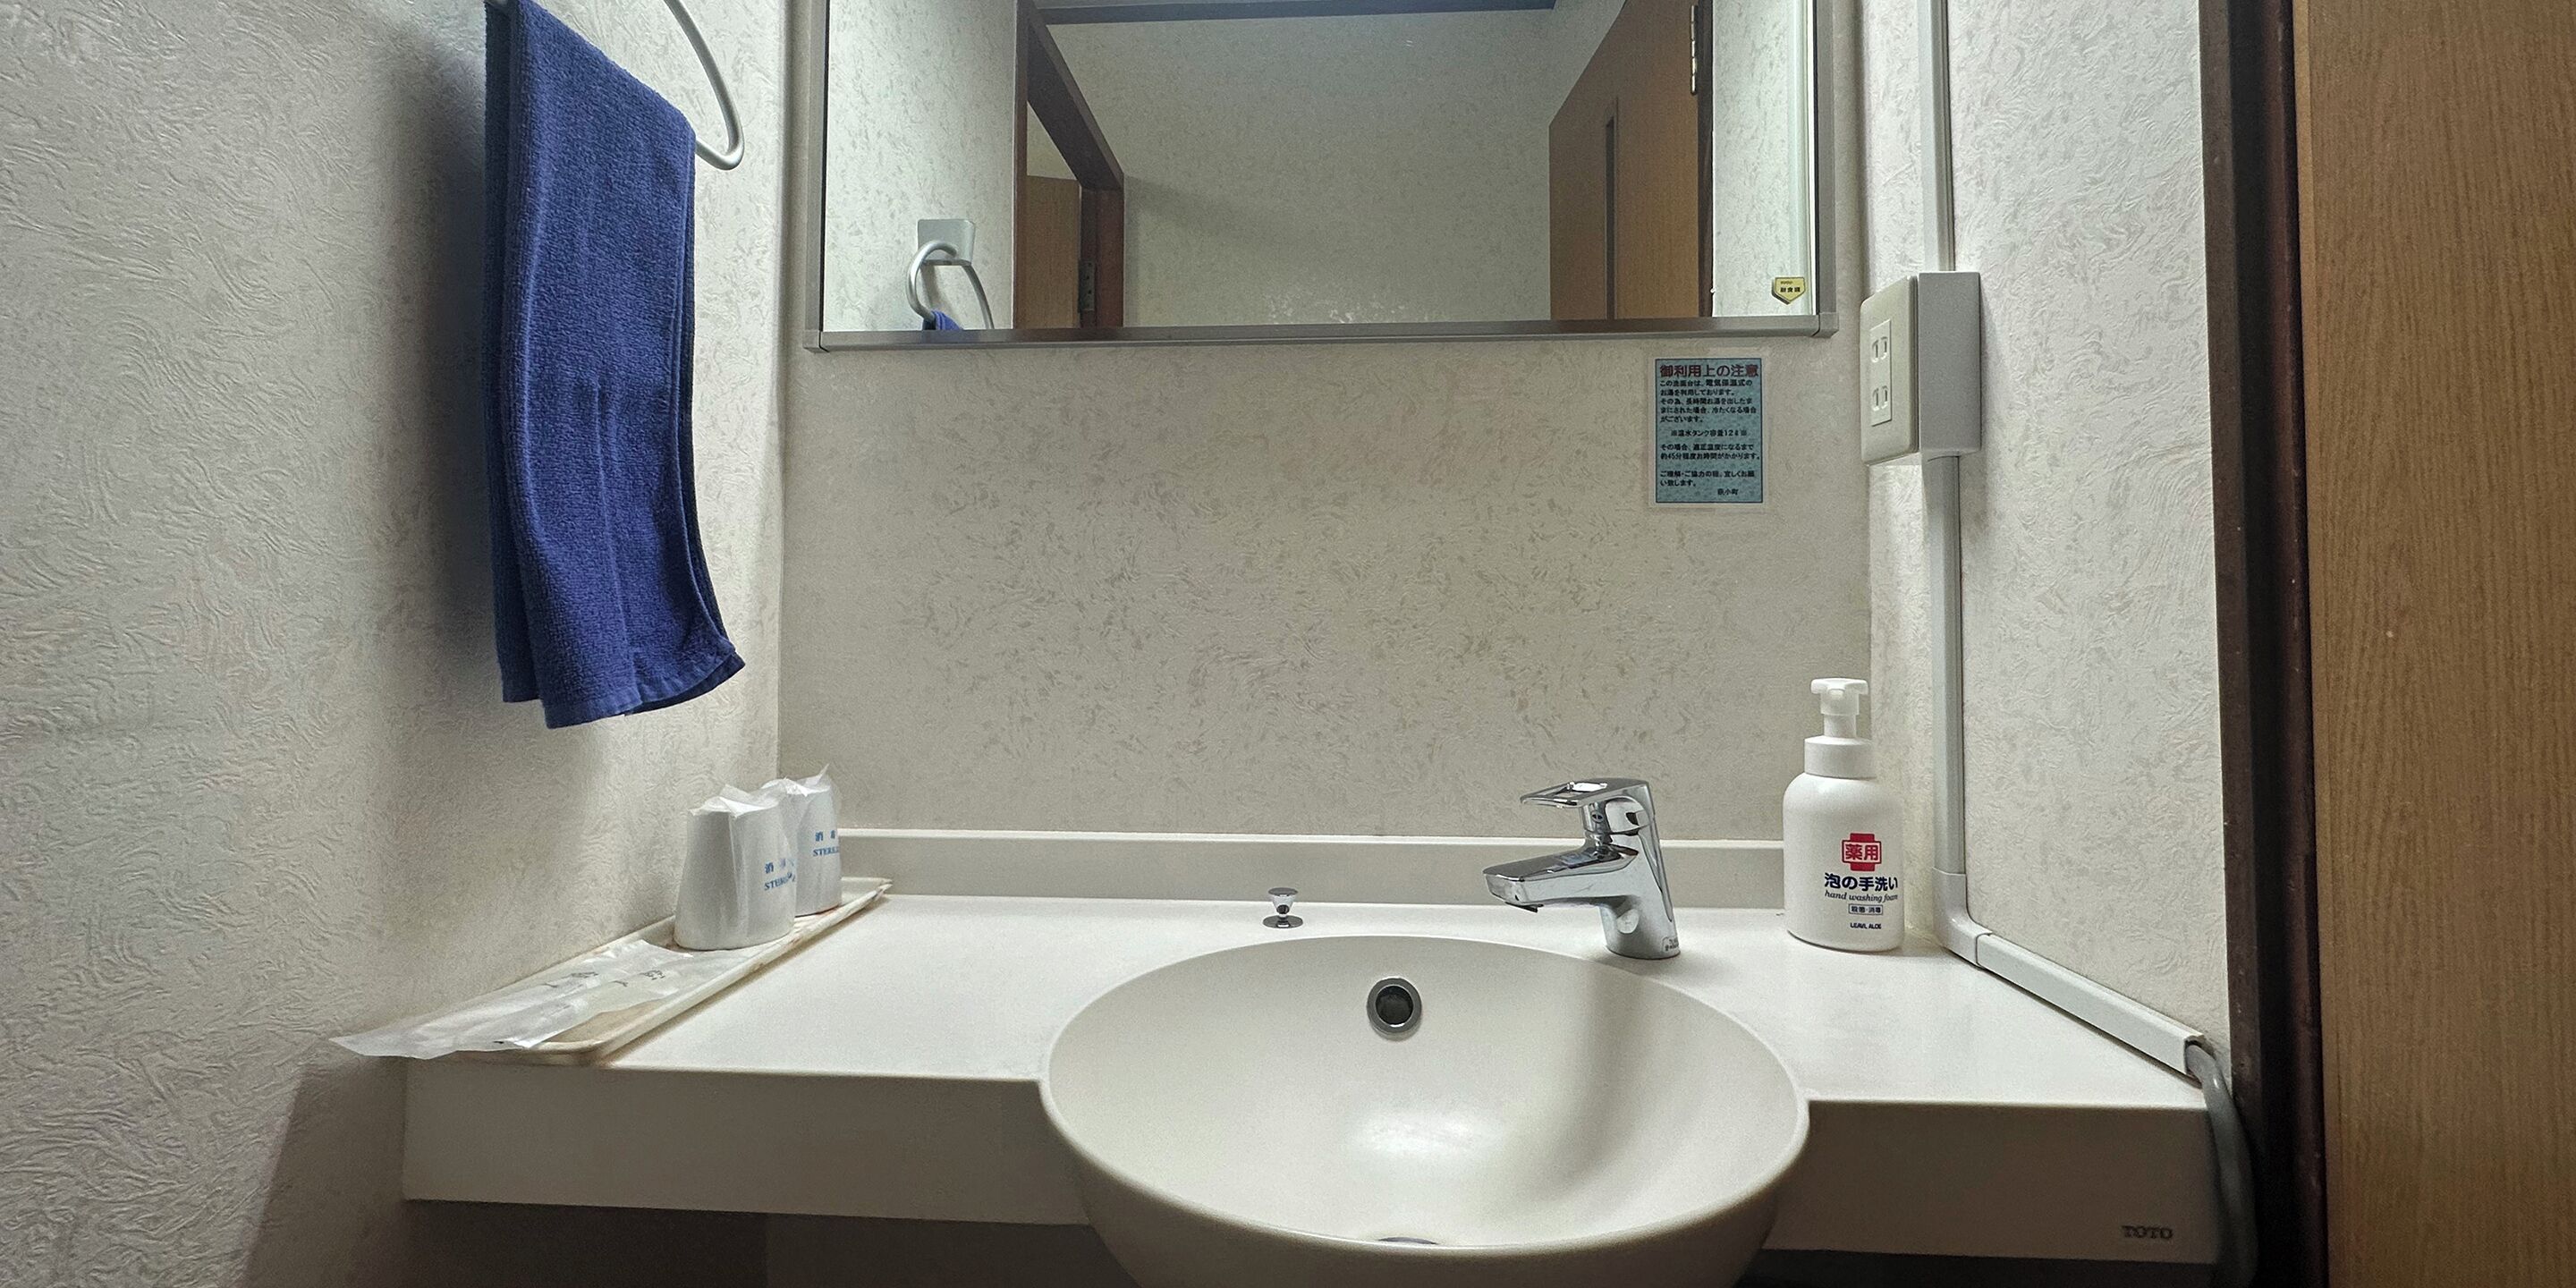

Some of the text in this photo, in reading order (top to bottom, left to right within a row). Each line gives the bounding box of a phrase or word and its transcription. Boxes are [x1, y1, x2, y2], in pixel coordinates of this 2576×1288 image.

[1659, 364, 1759, 377] 御利用上の注意
[1660, 415, 1704, 423] がございます。
[1844, 843, 1879, 860] 薬用
[1824, 872, 1898, 892] 泡の手洗い
[1824, 890, 1847, 900] hand
[1849, 894, 1883, 903] washing
[2121, 1225, 2174, 1240] TOTO
